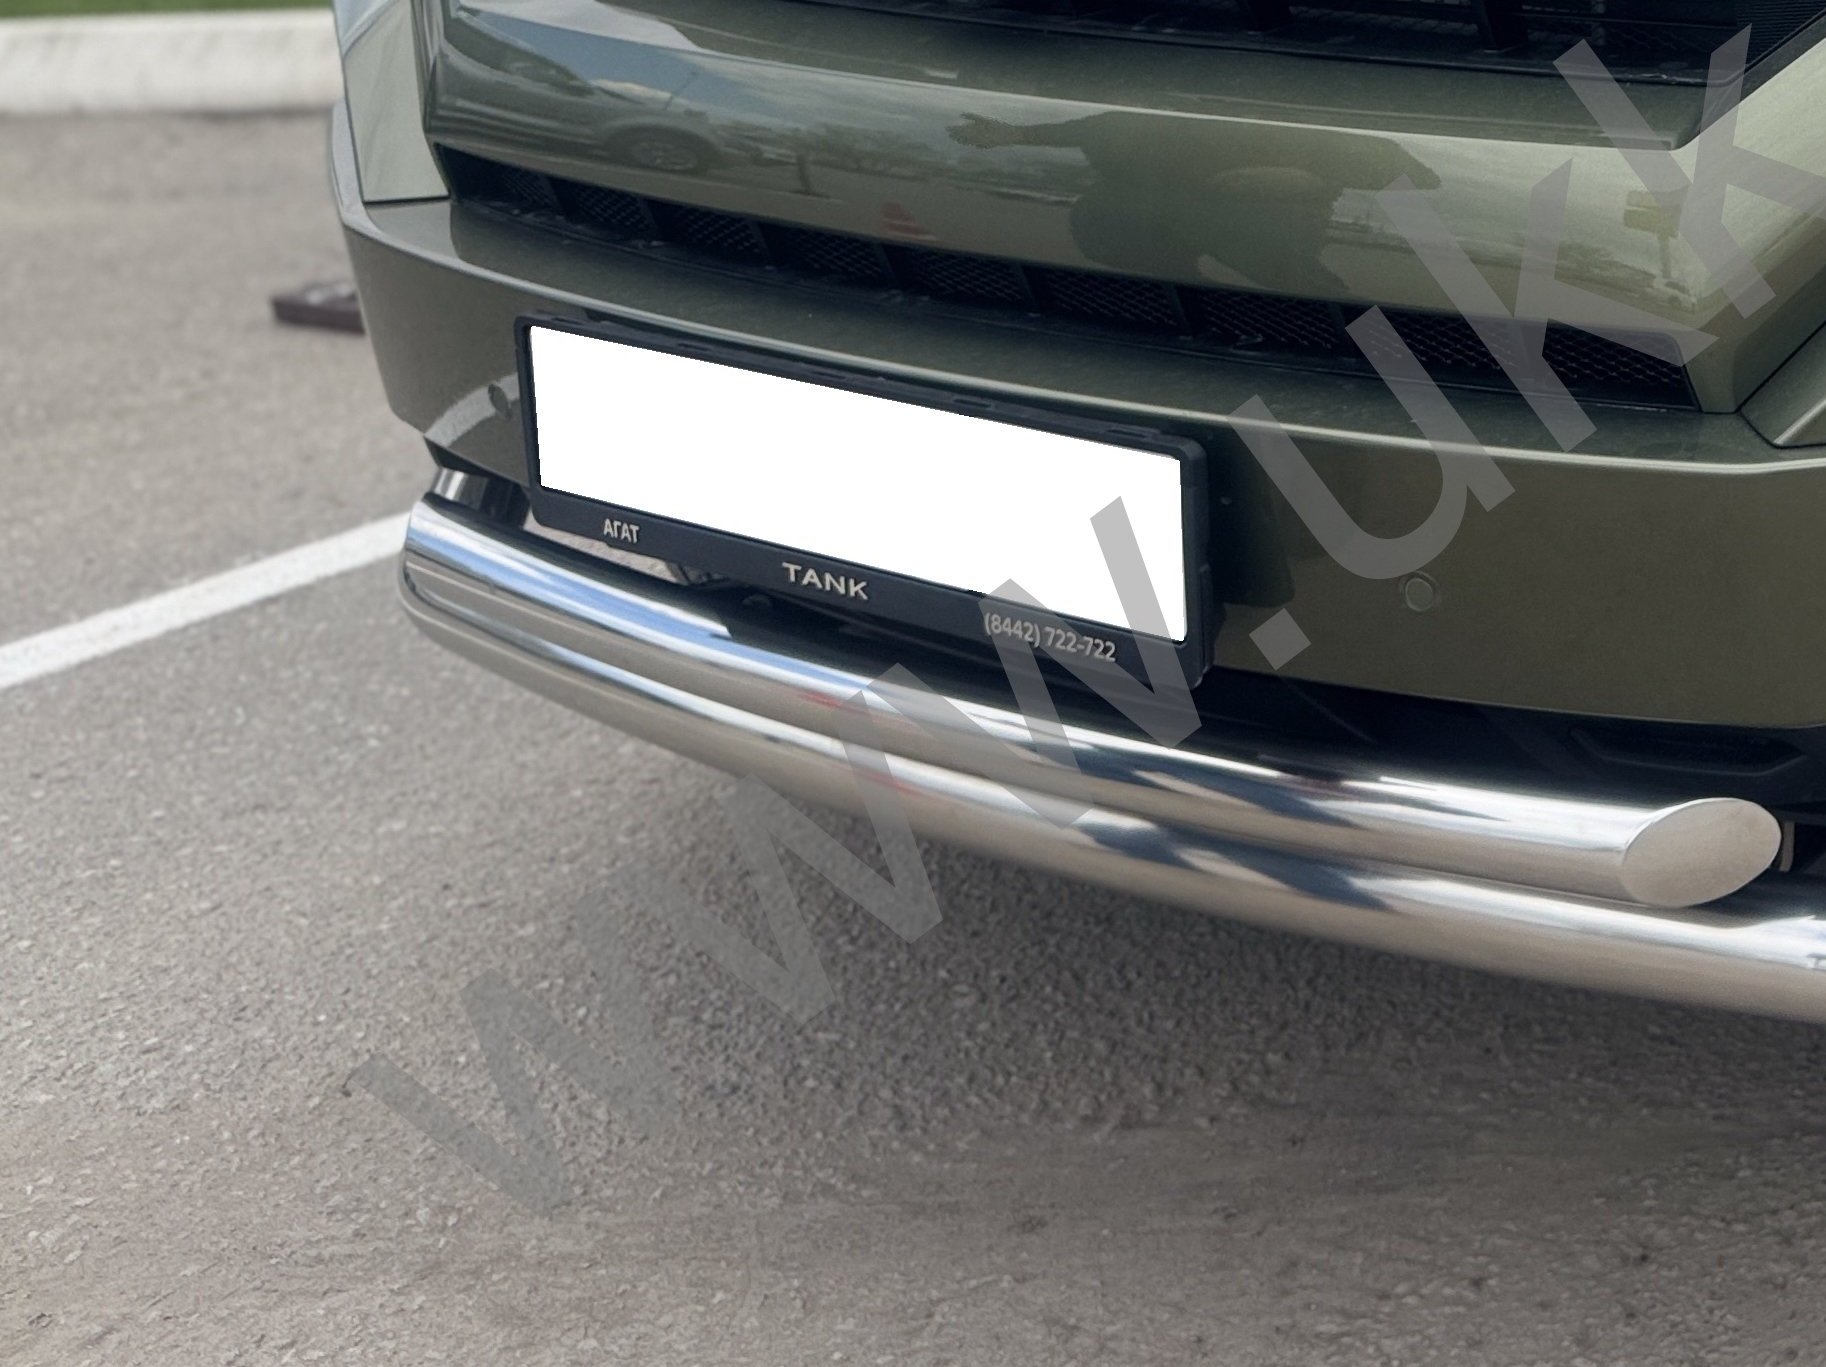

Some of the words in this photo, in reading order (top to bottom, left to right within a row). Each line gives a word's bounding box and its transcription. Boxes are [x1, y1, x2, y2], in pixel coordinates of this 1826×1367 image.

[603, 518, 640, 544] АГАТ
[782, 562, 869, 600] TANK
[985, 612, 1041, 648] (8442)
[1044, 626, 1116, 663] 722-722
